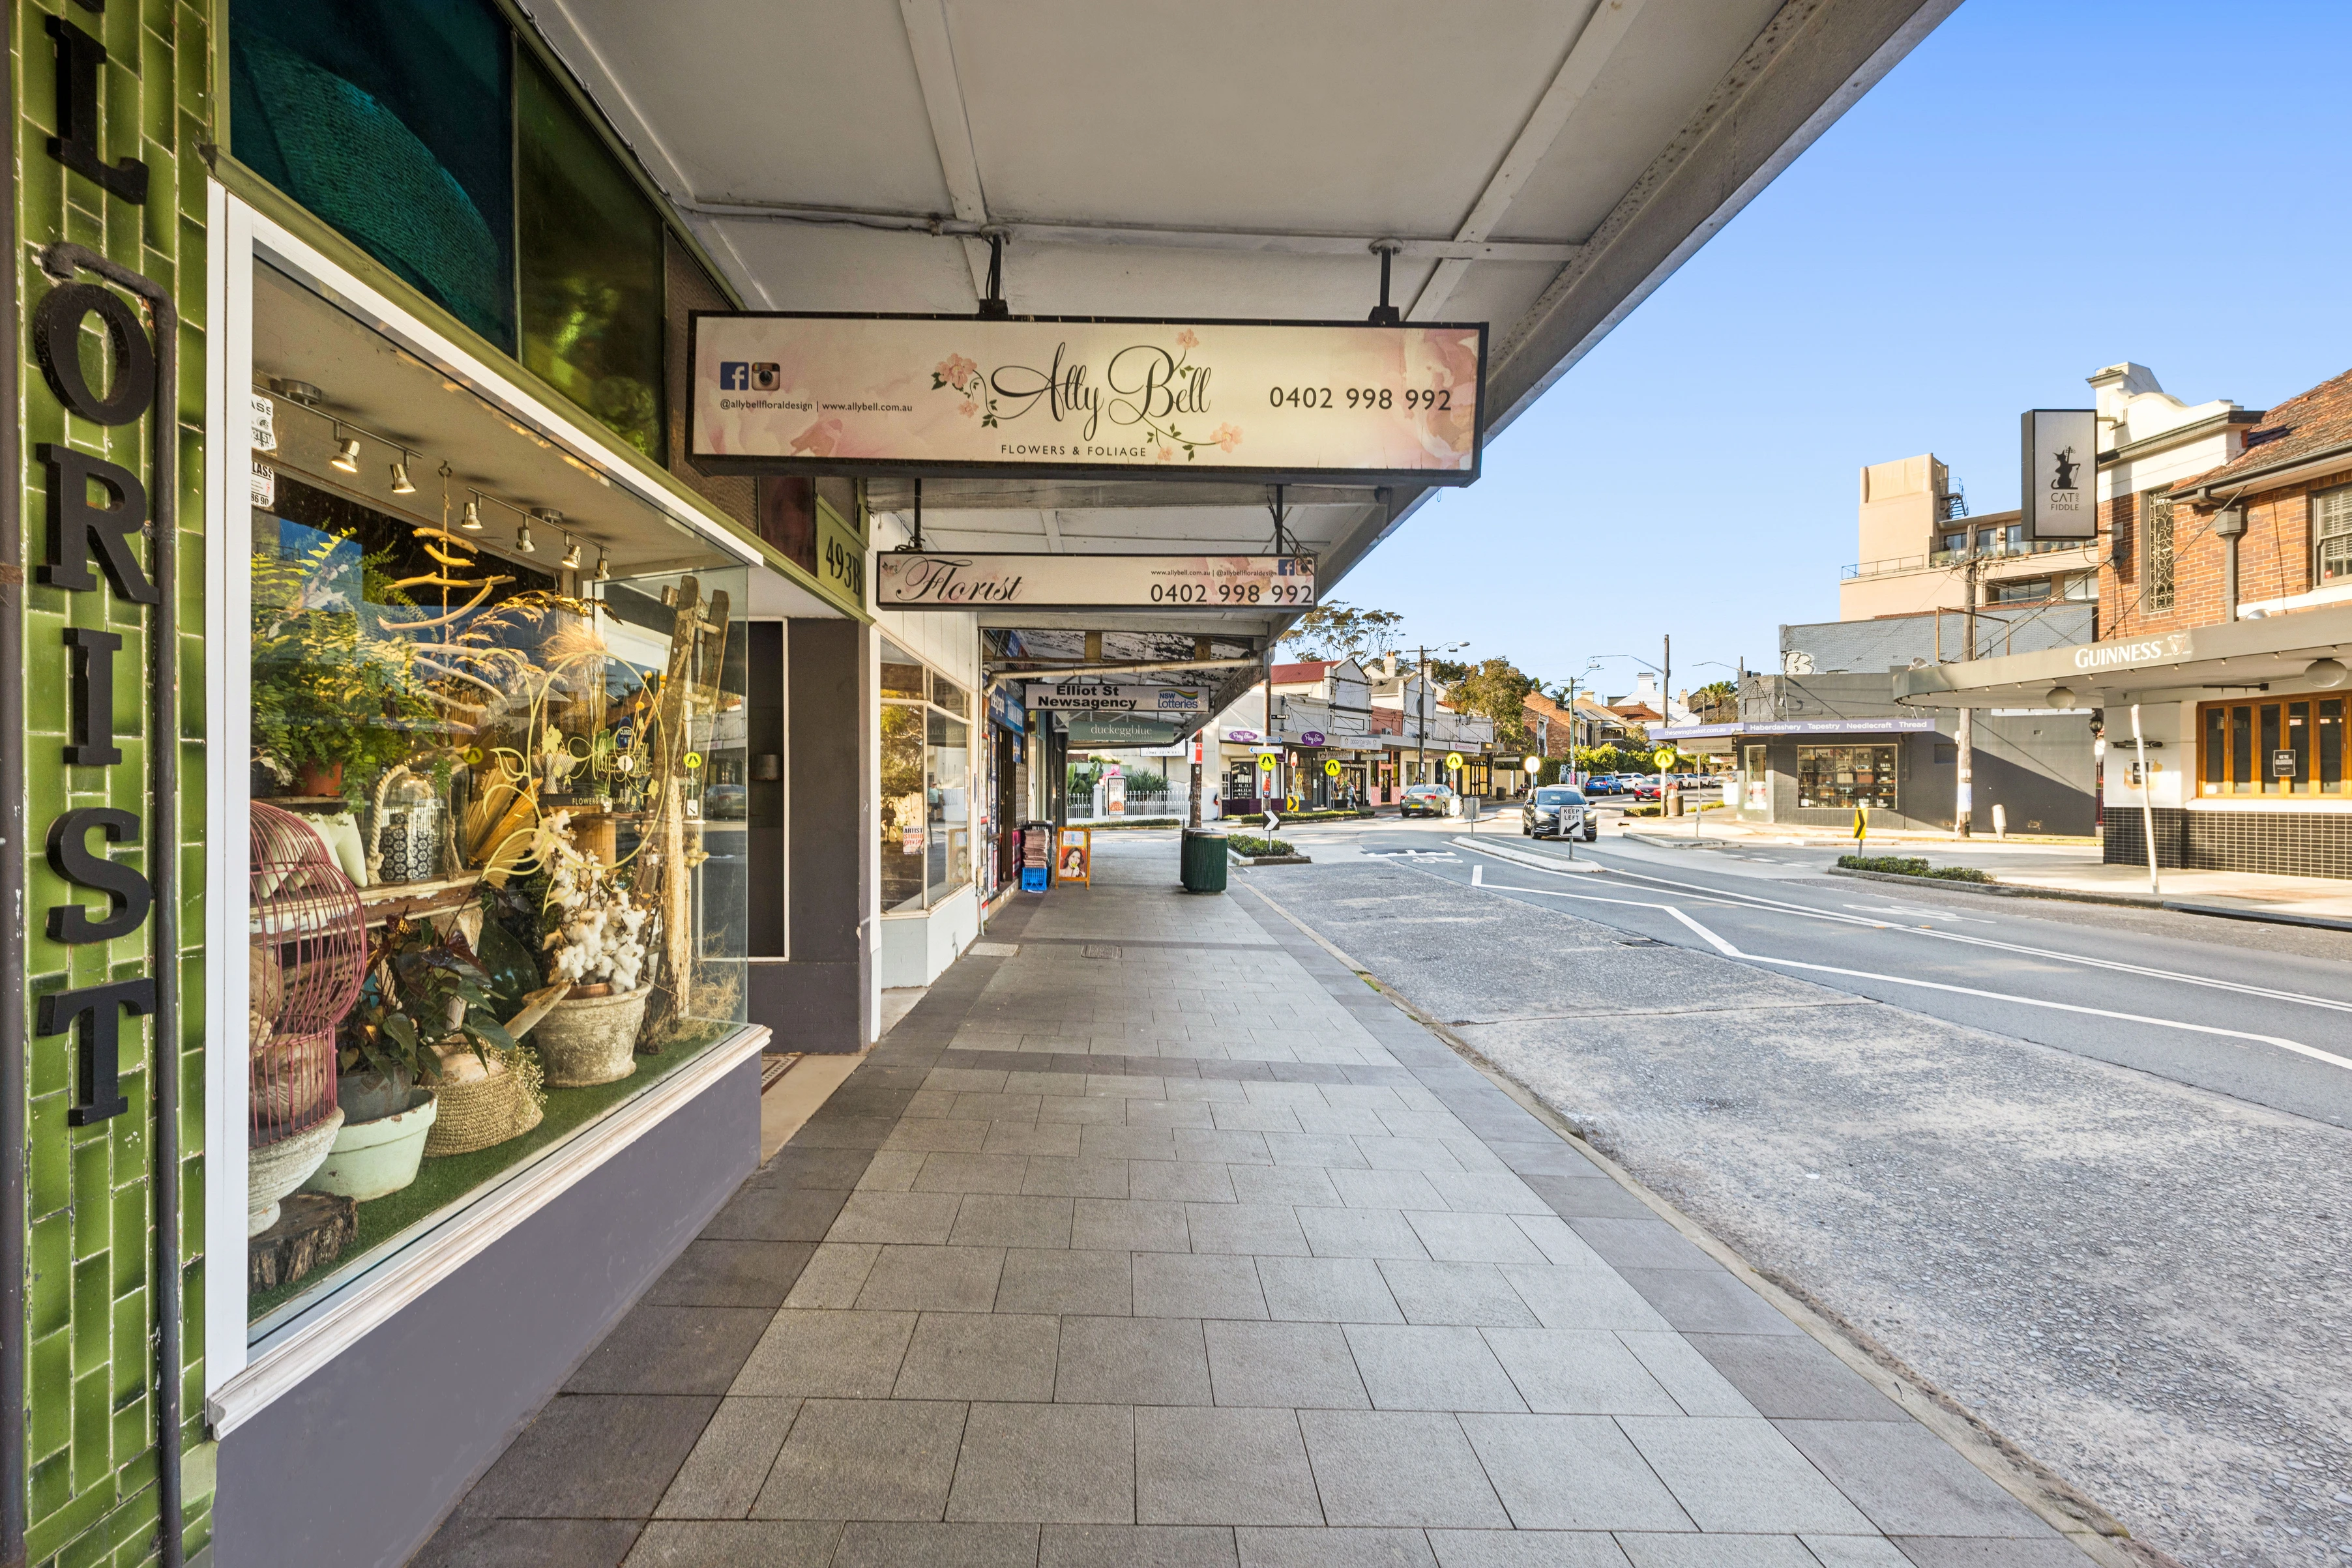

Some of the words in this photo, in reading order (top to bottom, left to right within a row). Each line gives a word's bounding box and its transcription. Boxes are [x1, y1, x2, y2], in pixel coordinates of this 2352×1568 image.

[990, 341, 1105, 442] Ally
[1108, 345, 1213, 426] Bell
[1269, 386, 1333, 409] 0402
[1345, 388, 1393, 410] 998
[1404, 390, 1452, 411] 992
[720, 399, 814, 412] @allybellfloraldesign
[821, 400, 913, 413] www.allybell.com.au
[1001, 444, 1066, 456] FLOWERS
[1072, 445, 1081, 456] &
[1087, 446, 1147, 457] FOLIAGE
[2051, 492, 2075, 502] CAT
[33, 0, 161, 1127] LORIST
[825, 535, 862, 596] 493B
[896, 556, 1022, 601] Florist
[1151, 584, 1207, 603] 0402
[1218, 585, 1260, 603] 998
[1271, 585, 1313, 603] 992
[2075, 641, 2162, 669] GUINNESS
[1056, 686, 1097, 696] Elliot
[1102, 686, 1119, 696] St
[1038, 696, 1138, 710] Newsagency
[1157, 699, 1198, 709] Lotteries
[1091, 723, 1153, 738] duckeggblue
[1665, 727, 1726, 736] thesewingbasket.com.au
[572, 797, 599, 806] FLOWERS
